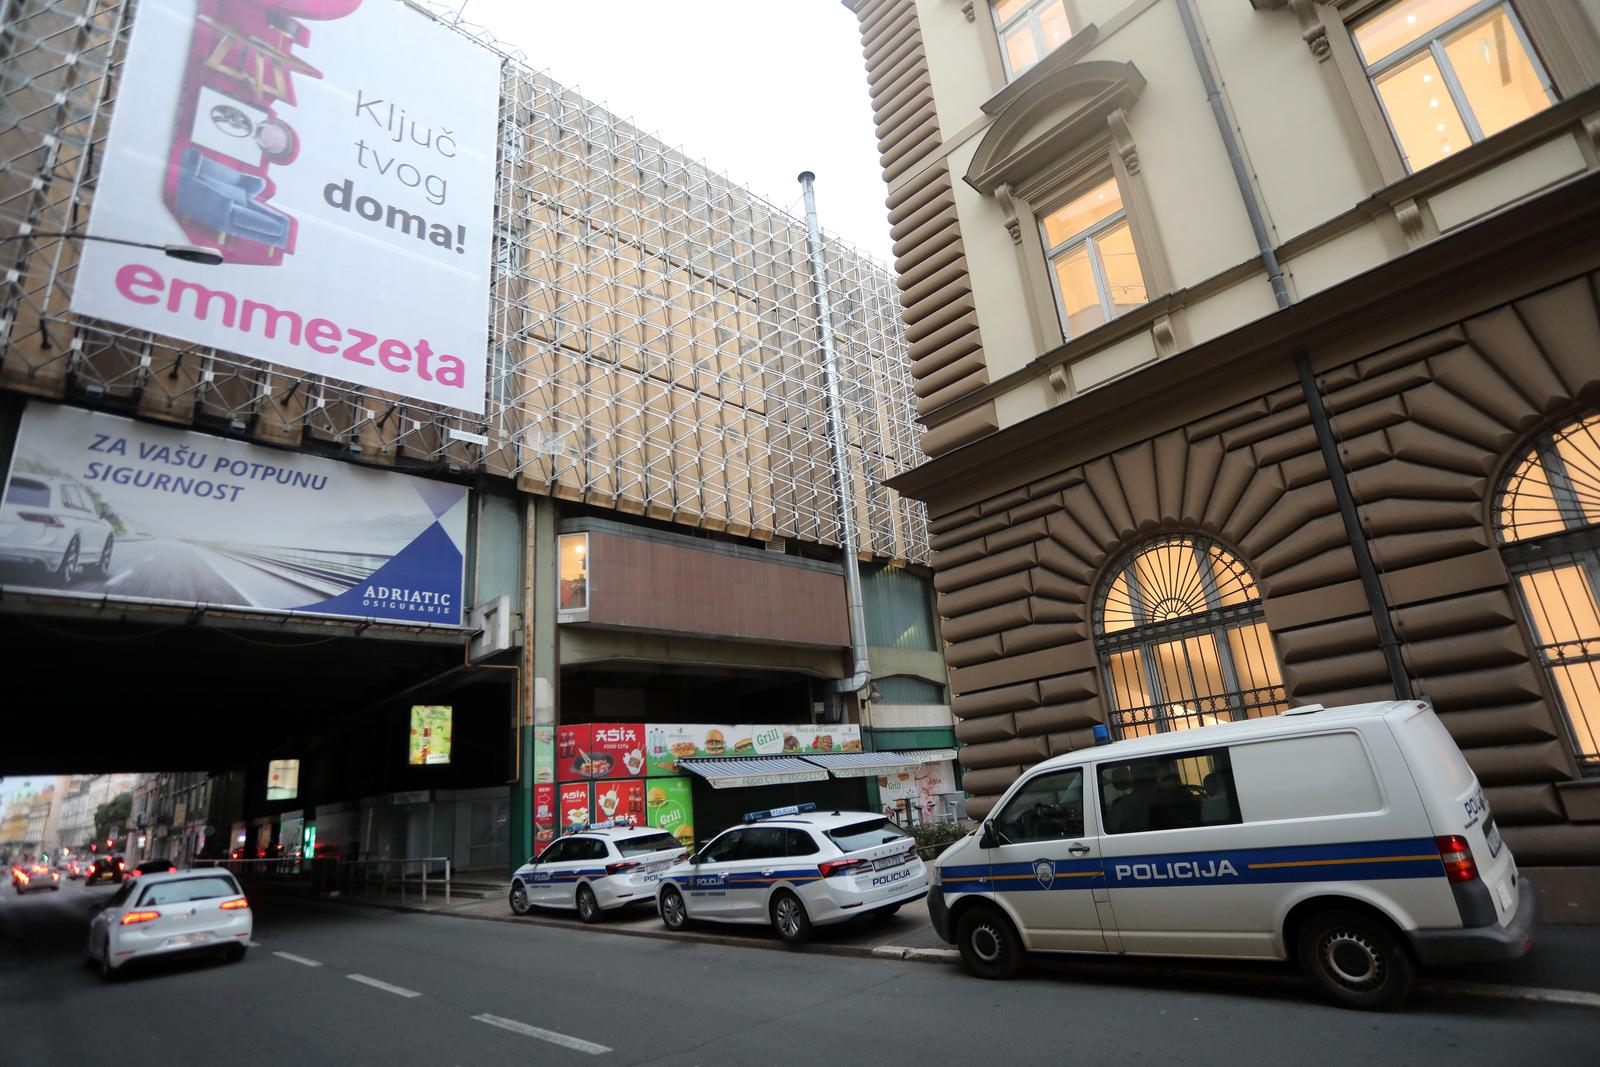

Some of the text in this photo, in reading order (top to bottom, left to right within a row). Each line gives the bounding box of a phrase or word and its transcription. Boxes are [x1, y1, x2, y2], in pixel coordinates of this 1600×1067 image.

[355, 90, 456, 158] Ključ
[354, 139, 447, 206] tvog
[323, 178, 466, 255] doma!
[115, 263, 466, 389] emmezeta
[87, 433, 329, 491] ZA VAŠU POTPUNU
[83, 461, 245, 502] SIGURNOST
[363, 585, 451, 606] ADRIATIC
[362, 599, 450, 615] OSIGURANJE
[756, 728, 780, 746] Grill
[660, 808, 681, 825] Grill
[771, 806, 797, 817] POLICIJA
[872, 868, 911, 887] POLICIJA
[1115, 859, 1239, 881] POLICIJA
[696, 877, 725, 886] POLICIJA
